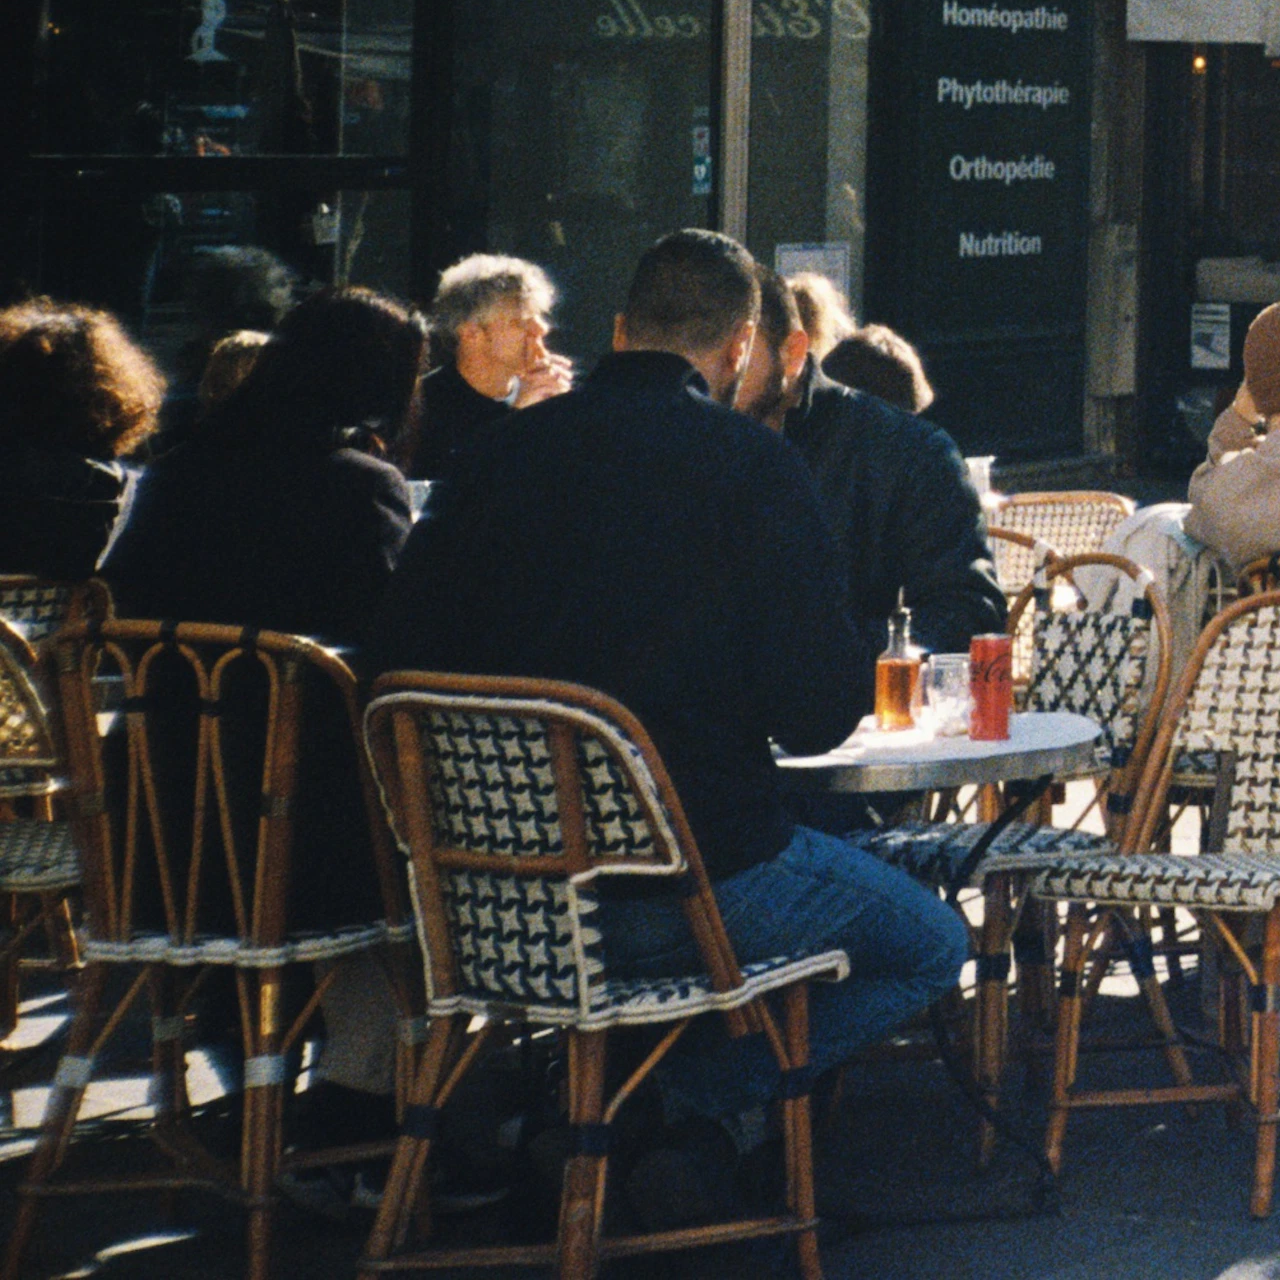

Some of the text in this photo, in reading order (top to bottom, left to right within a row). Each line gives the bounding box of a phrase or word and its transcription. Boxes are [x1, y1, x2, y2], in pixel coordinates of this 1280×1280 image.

[943, 0, 1068, 32] Homéopathie
[937, 77, 1070, 108] Phytothérapie
[950, 154, 1055, 183] Orthopédie
[959, 231, 1041, 257] Nutrition
